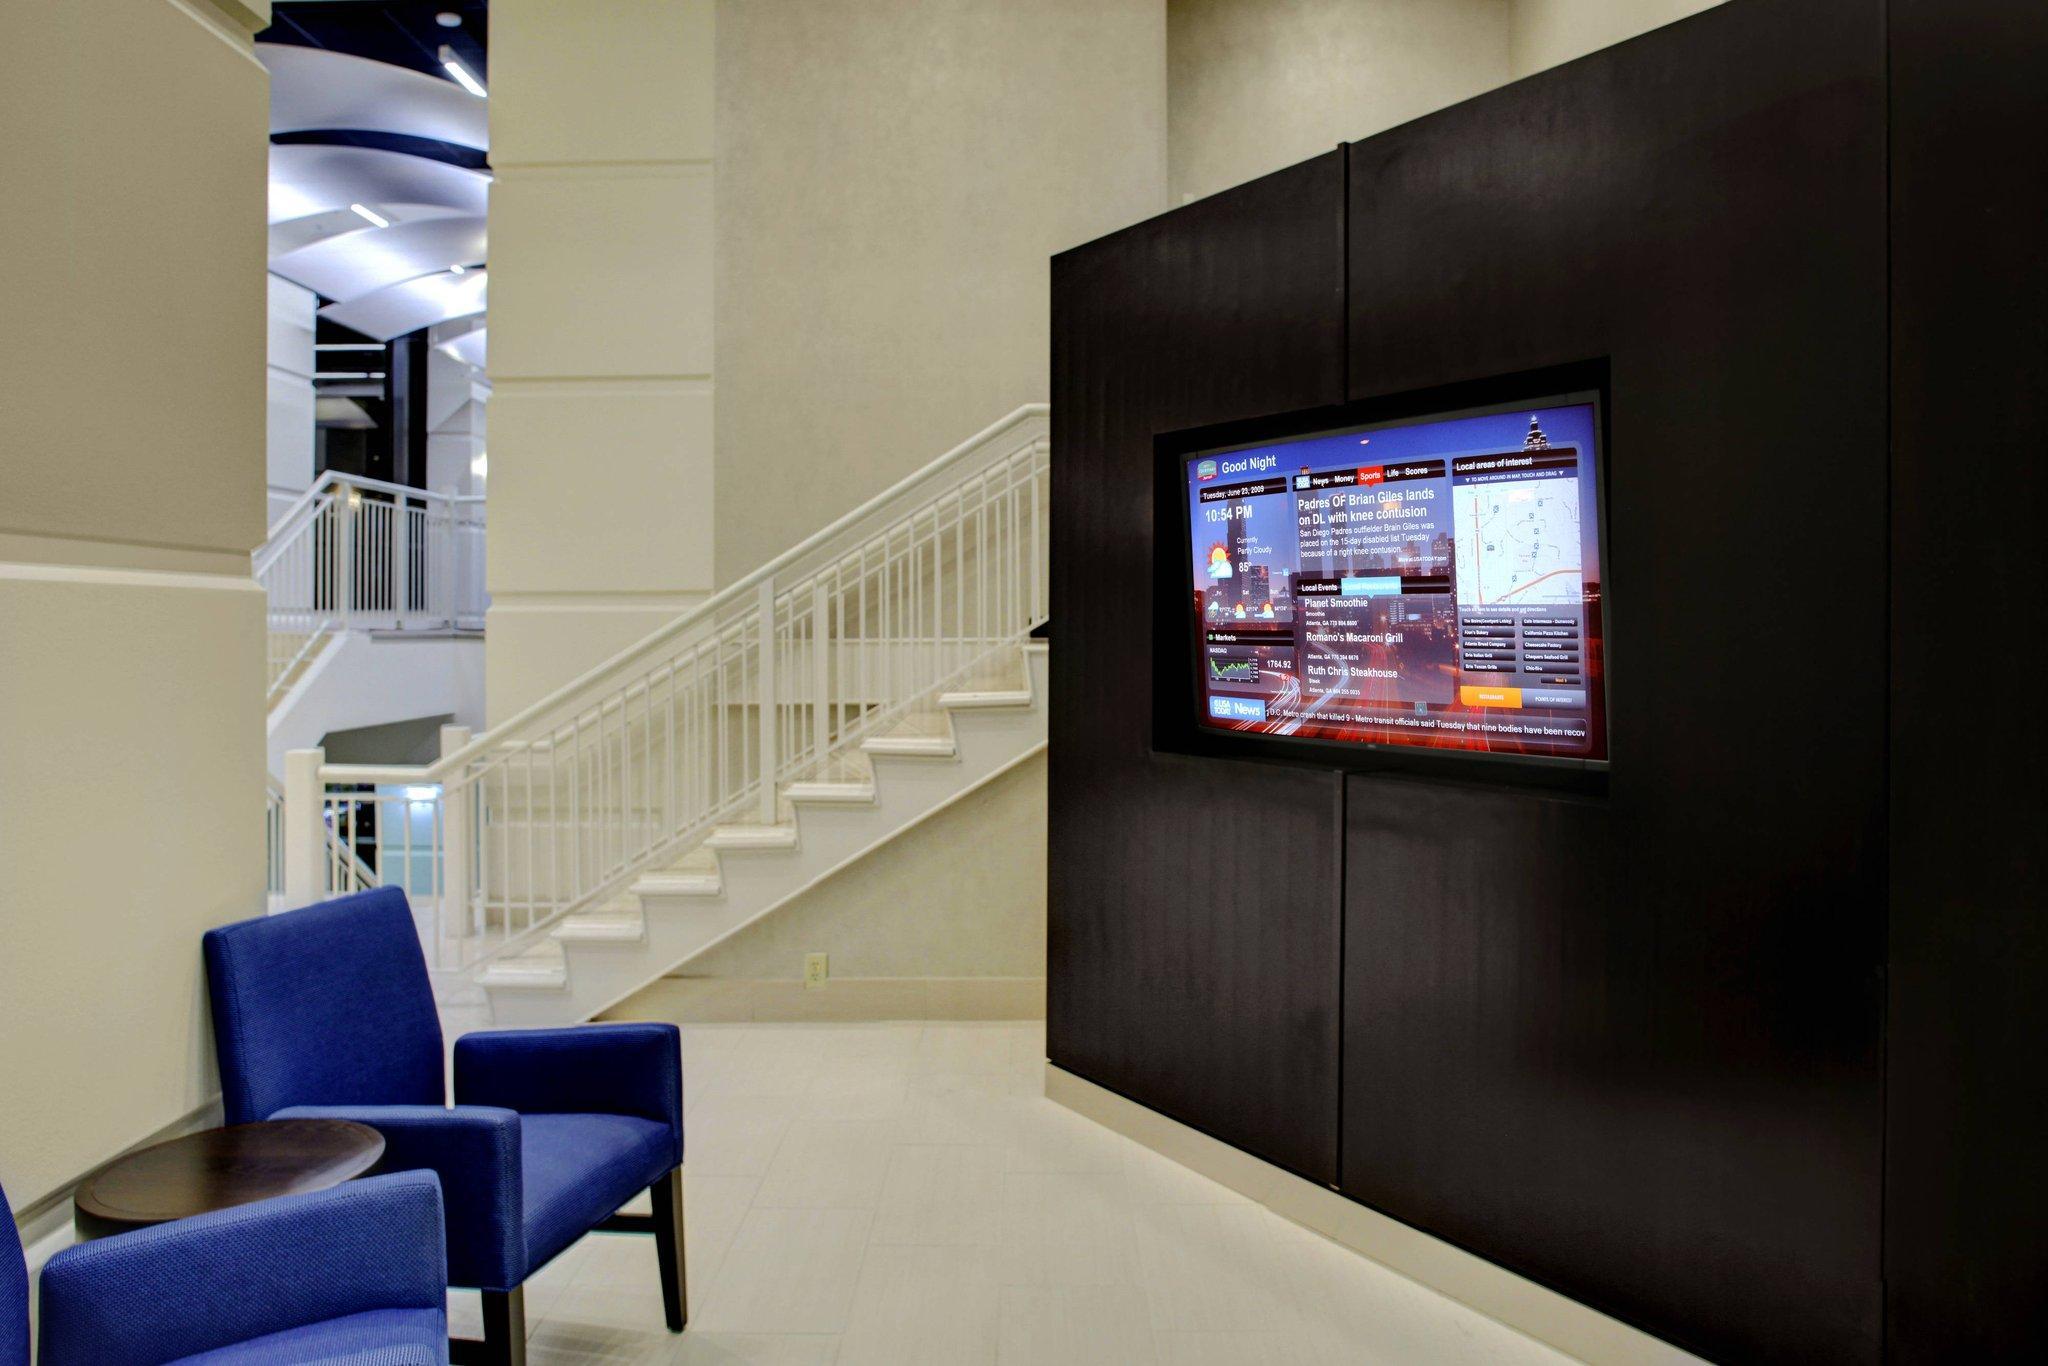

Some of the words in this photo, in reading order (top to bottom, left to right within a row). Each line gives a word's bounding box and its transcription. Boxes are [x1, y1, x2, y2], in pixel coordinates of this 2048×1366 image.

[1222, 459, 1247, 473] Good
[1250, 454, 1277, 471] Night
[1456, 461, 1475, 471] Local
[1476, 460, 1496, 469] areas
[1496, 458, 1505, 468] of
[1505, 456, 1533, 467] interest
[1313, 477, 1330, 487] News
[1334, 474, 1355, 483] Money
[1360, 471, 1381, 481] Sports
[1386, 468, 1399, 478] Life
[1405, 467, 1428, 476] Scores
[1203, 492, 1227, 500] Tuesday,
[1227, 489, 1240, 497] June
[1251, 485, 1265, 493] 2009
[1298, 497, 1331, 511] Padres
[1332, 494, 1346, 508] OF
[1348, 493, 1375, 506] Brian
[1377, 490, 1404, 504] Giles
[1406, 487, 1435, 501] lands
[1206, 507, 1233, 522] 10:54
[1236, 504, 1253, 520] PM
[1298, 516, 1311, 526] on
[1313, 513, 1326, 525] DL
[1328, 511, 1347, 524] with
[1350, 510, 1374, 522] knee
[1376, 505, 1427, 520] contusion
[1300, 529, 1311, 538] San
[1312, 528, 1330, 538] Diego
[1331, 527, 1353, 536] Padres
[1402, 522, 1420, 531] Giles
[1420, 522, 1435, 530] was
[1300, 539, 1320, 548] placed
[1329, 538, 1340, 546] the
[1341, 537, 1361, 546] 15-day
[1362, 535, 1390, 544] disabled
[1390, 534, 1400, 542] list
[1400, 533, 1430, 543] Tuesday
[1301, 550, 1325, 558] because
[1326, 548, 1333, 557] of
[1339, 547, 1353, 558] right
[1354, 547, 1369, 555] knee
[1301, 584, 1317, 592] Local
[1318, 583, 1338, 591] Events
[1304, 598, 1329, 608] Planet
[1330, 597, 1369, 608] Smoothie
[1215, 634, 1237, 642] Markets
[1306, 632, 1344, 642] Romano's
[1346, 632, 1384, 643] Macaroni
[1385, 632, 1403, 643] Grill
[1307, 665, 1326, 675] Ruth
[1327, 665, 1349, 676] Chris
[1350, 666, 1398, 678] Steakhouse
[1234, 702, 1260, 717] News
[1283, 709, 1299, 718] Metro
[1316, 711, 1328, 720] that
[1329, 713, 1345, 721] killed
[1355, 714, 1373, 724] Metro
[1374, 716, 1393, 725] transit
[1394, 717, 1419, 727] officials
[1420, 719, 1435, 728] said
[1436, 719, 1466, 731] Tuesday
[1466, 722, 1480, 731] that
[1481, 723, 1497, 732] nine
[1498, 723, 1523, 733] bodies
[1524, 724, 1542, 735] have
[1543, 725, 1563, 736] been
[1564, 728, 1586, 737] recov
